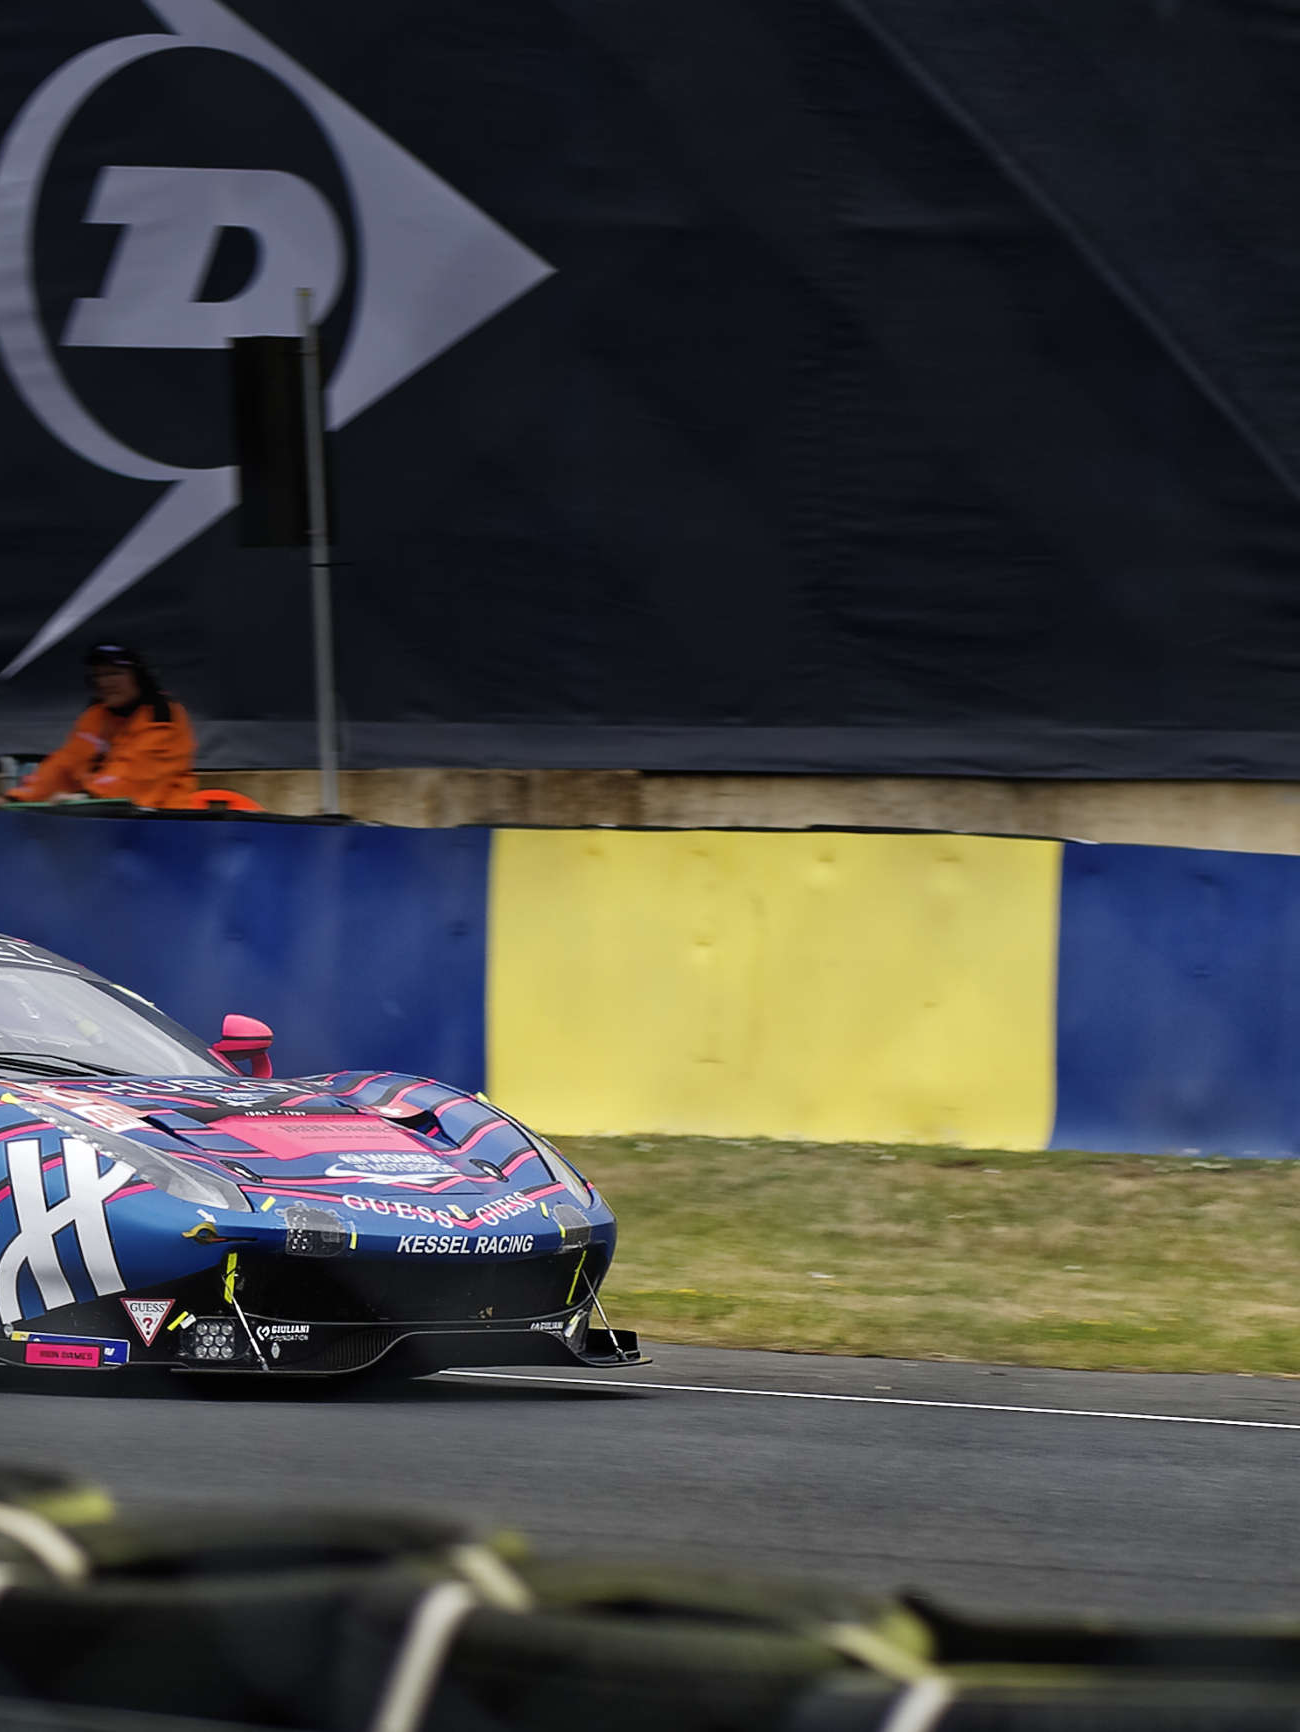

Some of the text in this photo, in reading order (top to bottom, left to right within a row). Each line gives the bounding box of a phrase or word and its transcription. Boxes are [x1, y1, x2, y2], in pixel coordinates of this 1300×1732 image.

[61, 165, 347, 349] D
[341, 1194, 455, 1229] GUESS
[475, 1191, 538, 1226] GUESS
[396, 1234, 534, 1254] KESSEL RACING
[130, 1303, 165, 1313] GUESS
